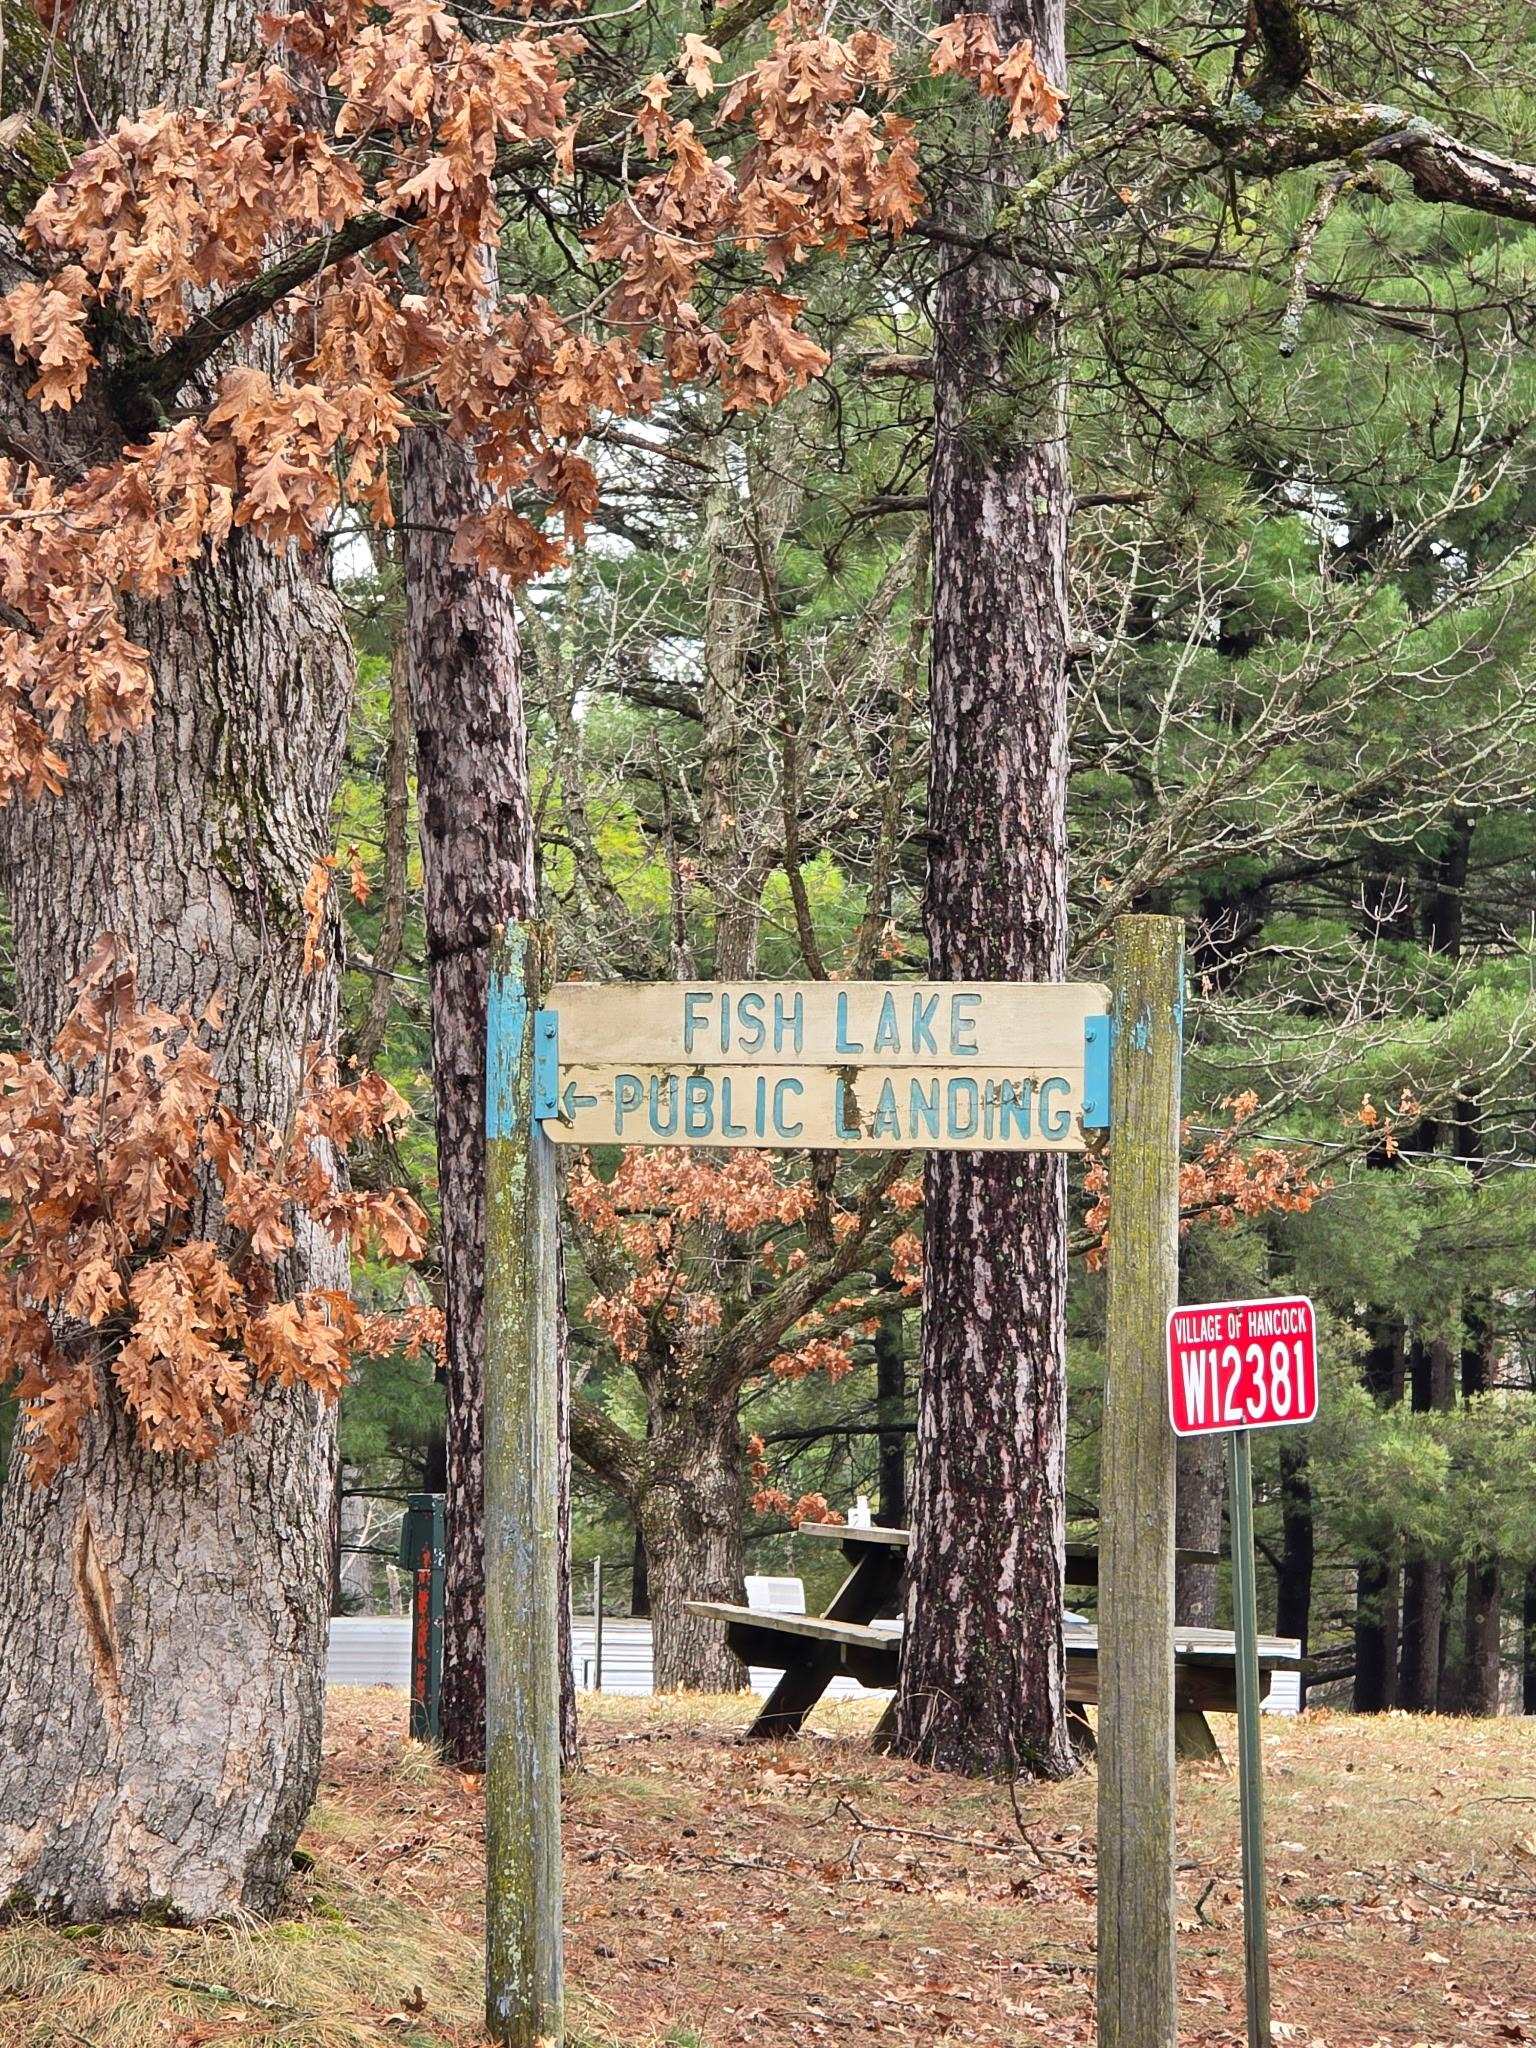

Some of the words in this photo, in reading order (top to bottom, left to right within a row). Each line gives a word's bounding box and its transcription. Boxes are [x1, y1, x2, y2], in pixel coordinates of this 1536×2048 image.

[684, 991, 803, 1055] FISH
[835, 991, 982, 1056] LAKE
[614, 1074, 804, 1138] PUBLIC
[835, 1075, 1072, 1141] LANDING
[1174, 1314, 1223, 1345] VILLAGE
[1227, 1312, 1244, 1340] OF
[1248, 1307, 1307, 1338] HANCOCK
[1180, 1339, 1306, 1426] W12381
